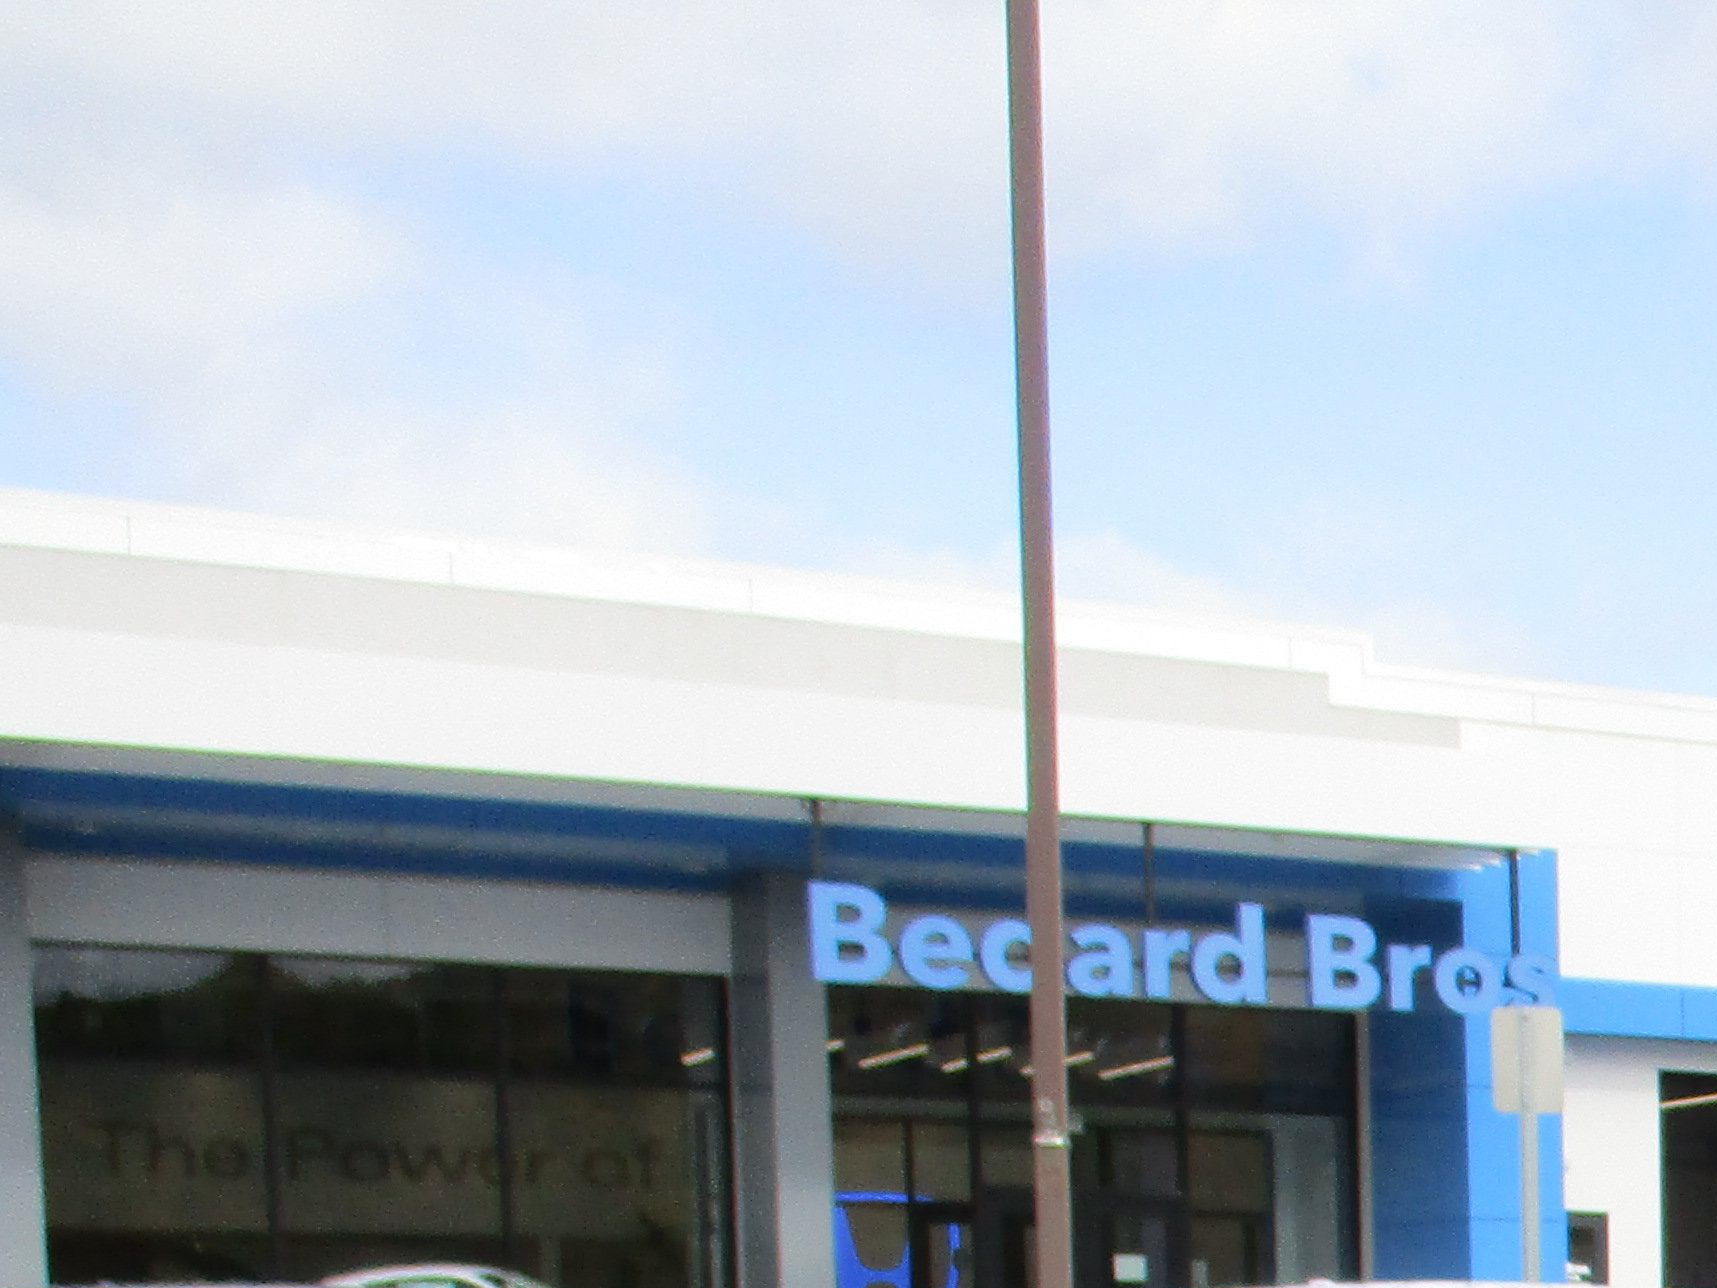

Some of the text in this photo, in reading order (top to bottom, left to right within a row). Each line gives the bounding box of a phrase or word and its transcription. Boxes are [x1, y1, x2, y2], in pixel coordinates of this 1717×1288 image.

[1308, 913, 1557, 1016] Bros
[94, 1118, 251, 1181] The
[286, 1124, 550, 1187] Power
